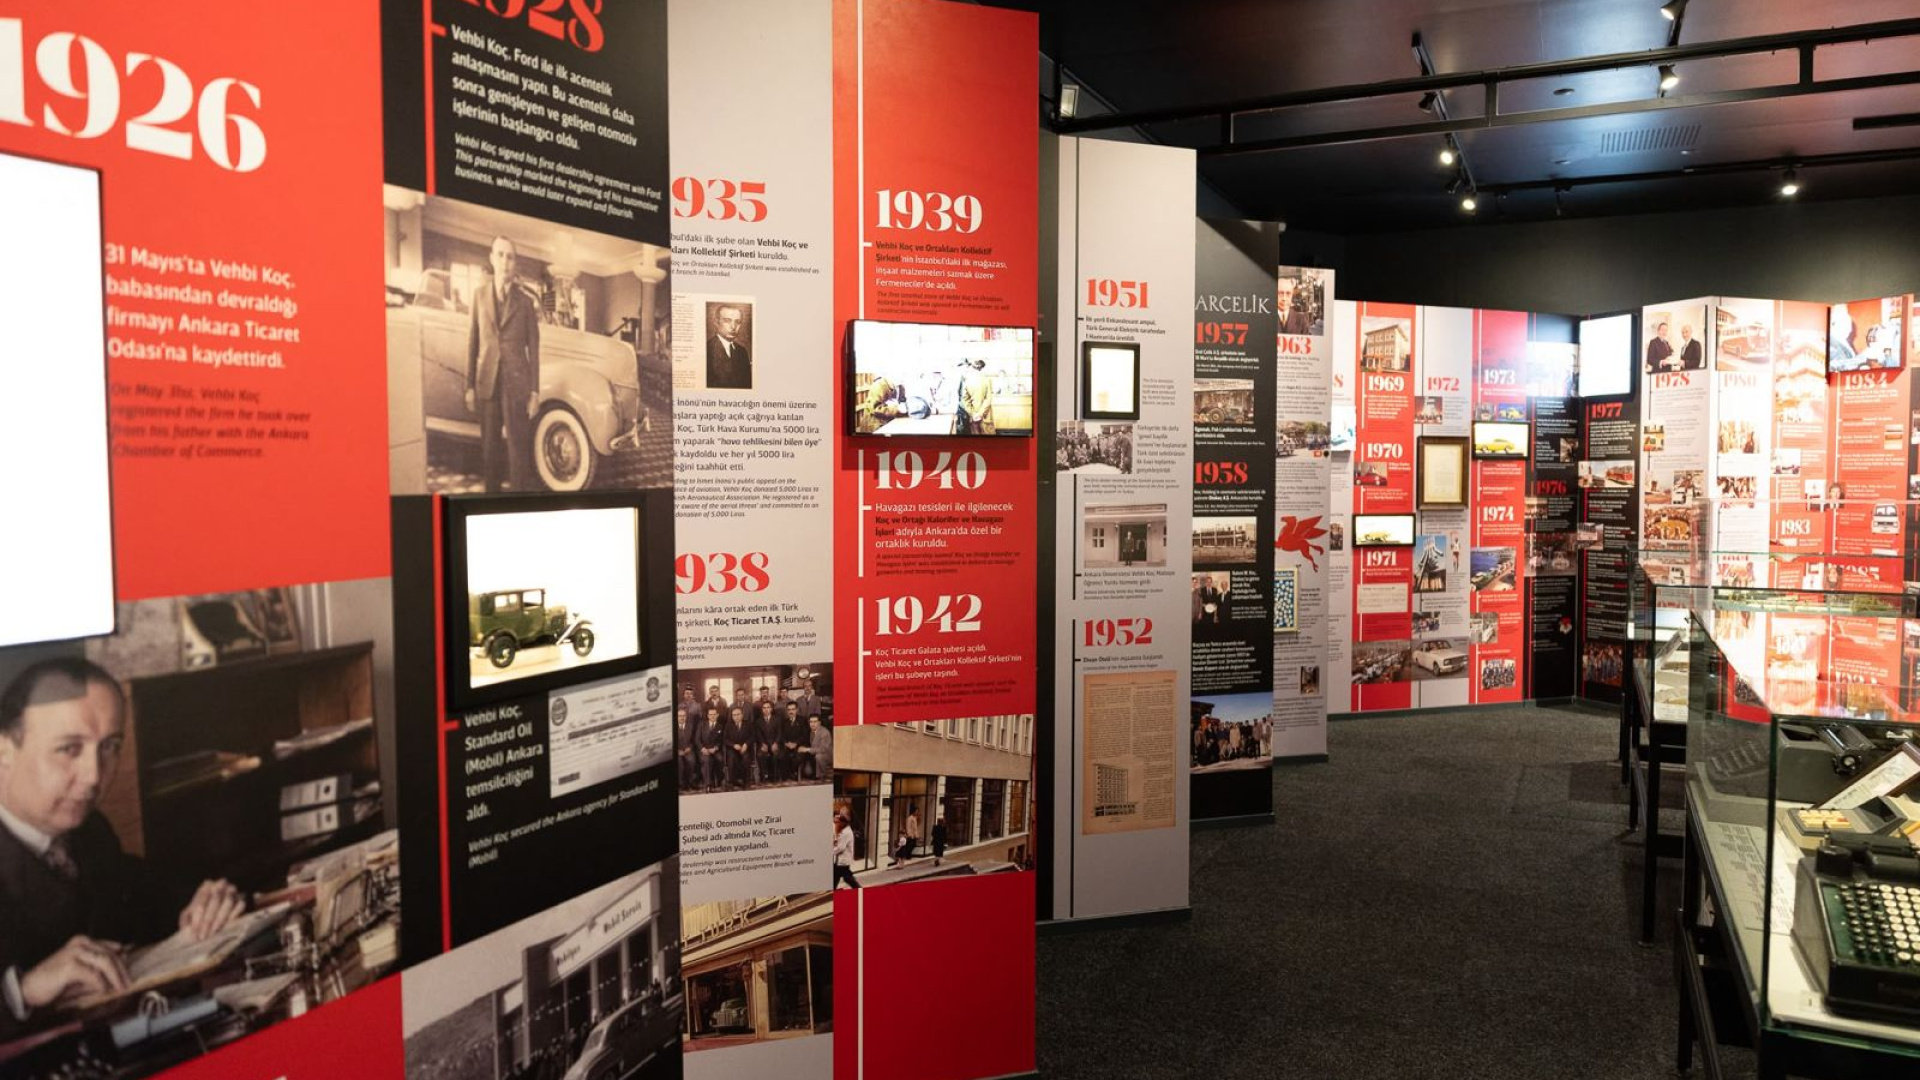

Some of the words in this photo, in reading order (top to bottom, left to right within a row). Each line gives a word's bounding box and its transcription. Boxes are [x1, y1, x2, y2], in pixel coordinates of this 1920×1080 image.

[455, 0, 604, 53] 28
[451, 23, 485, 50] Vehbi
[514, 48, 539, 70] Ford
[541, 59, 554, 75] ile
[556, 63, 568, 80] ilk
[570, 71, 613, 97] acentelik
[0, 17, 267, 172] 1926
[452, 51, 520, 86] anlaşmasını
[552, 86, 566, 102] Bu
[568, 93, 610, 117] acentelik
[612, 107, 635, 126] daha
[452, 76, 485, 98] sonra
[488, 88, 545, 117] genişleyen
[547, 108, 559, 121] ve
[561, 112, 595, 133] gelişen
[598, 125, 637, 147] otomotiv
[501, 113, 554, 142] başlangıcı
[875, 189, 983, 234] 1939
[716, 236, 736, 246] şube
[737, 237, 755, 246] olan
[757, 238, 780, 247] Vehbi
[782, 240, 796, 250] Koç
[105, 243, 125, 264] 31
[131, 247, 205, 275] Mayıs'ta
[691, 247, 726, 257] Kollektif
[728, 249, 756, 259] Şirketi
[106, 274, 212, 305] babasından
[217, 289, 298, 319] devraldığı
[1086, 279, 1148, 309] 1951
[1195, 294, 1271, 314] ARÇELİK
[107, 306, 174, 334] firmayı
[178, 313, 240, 337] Ankara
[245, 320, 300, 343] Ticaret
[1196, 322, 1248, 346] 1957
[108, 337, 187, 363] Odası'na
[1368, 375, 1405, 392] 1969
[1428, 377, 1459, 391] 1972
[1483, 369, 1516, 385] 1973
[728, 413, 745, 421] açık
[1591, 402, 1623, 418] 1977
[718, 425, 737, 433] Hava
[683, 438, 715, 447] yaparak
[1367, 443, 1403, 458] 1970
[680, 450, 717, 459] kaydoldu
[731, 450, 745, 458] her
[758, 450, 780, 458] 5000
[875, 450, 987, 490] 1940
[1195, 462, 1248, 484] 1958
[954, 502, 966, 511] ile
[968, 503, 1014, 513] ilgilenecek
[1482, 506, 1514, 522] 1974
[925, 526, 968, 535] Ankara'da
[971, 526, 988, 535] özel
[991, 526, 1002, 535] bir
[1780, 519, 1810, 535] 1983
[1366, 551, 1397, 566] 1971
[725, 604, 745, 613] ortak
[781, 603, 799, 611] Türk
[875, 593, 982, 635] 1942
[714, 617, 729, 626] Koç
[731, 617, 759, 625] Ticaret
[1084, 617, 1153, 647] 1952
[876, 648, 889, 657] Koç
[891, 647, 916, 655] Ticaret
[918, 646, 941, 655] Galata
[876, 660, 896, 668] Vehbi
[897, 659, 911, 668] Koç
[895, 670, 904, 679] bu
[465, 725, 515, 751] Standard
[517, 721, 533, 738] Oil
[465, 751, 505, 775] (Mobil)
[506, 743, 544, 764] Ankara
[716, 818, 752, 828] Otomobil
[682, 835, 709, 845] Şubesi
[724, 832, 750, 841] altında
[752, 830, 767, 838] Koç
[769, 827, 795, 835] Ticaret
[701, 845, 733, 856] yeniden
